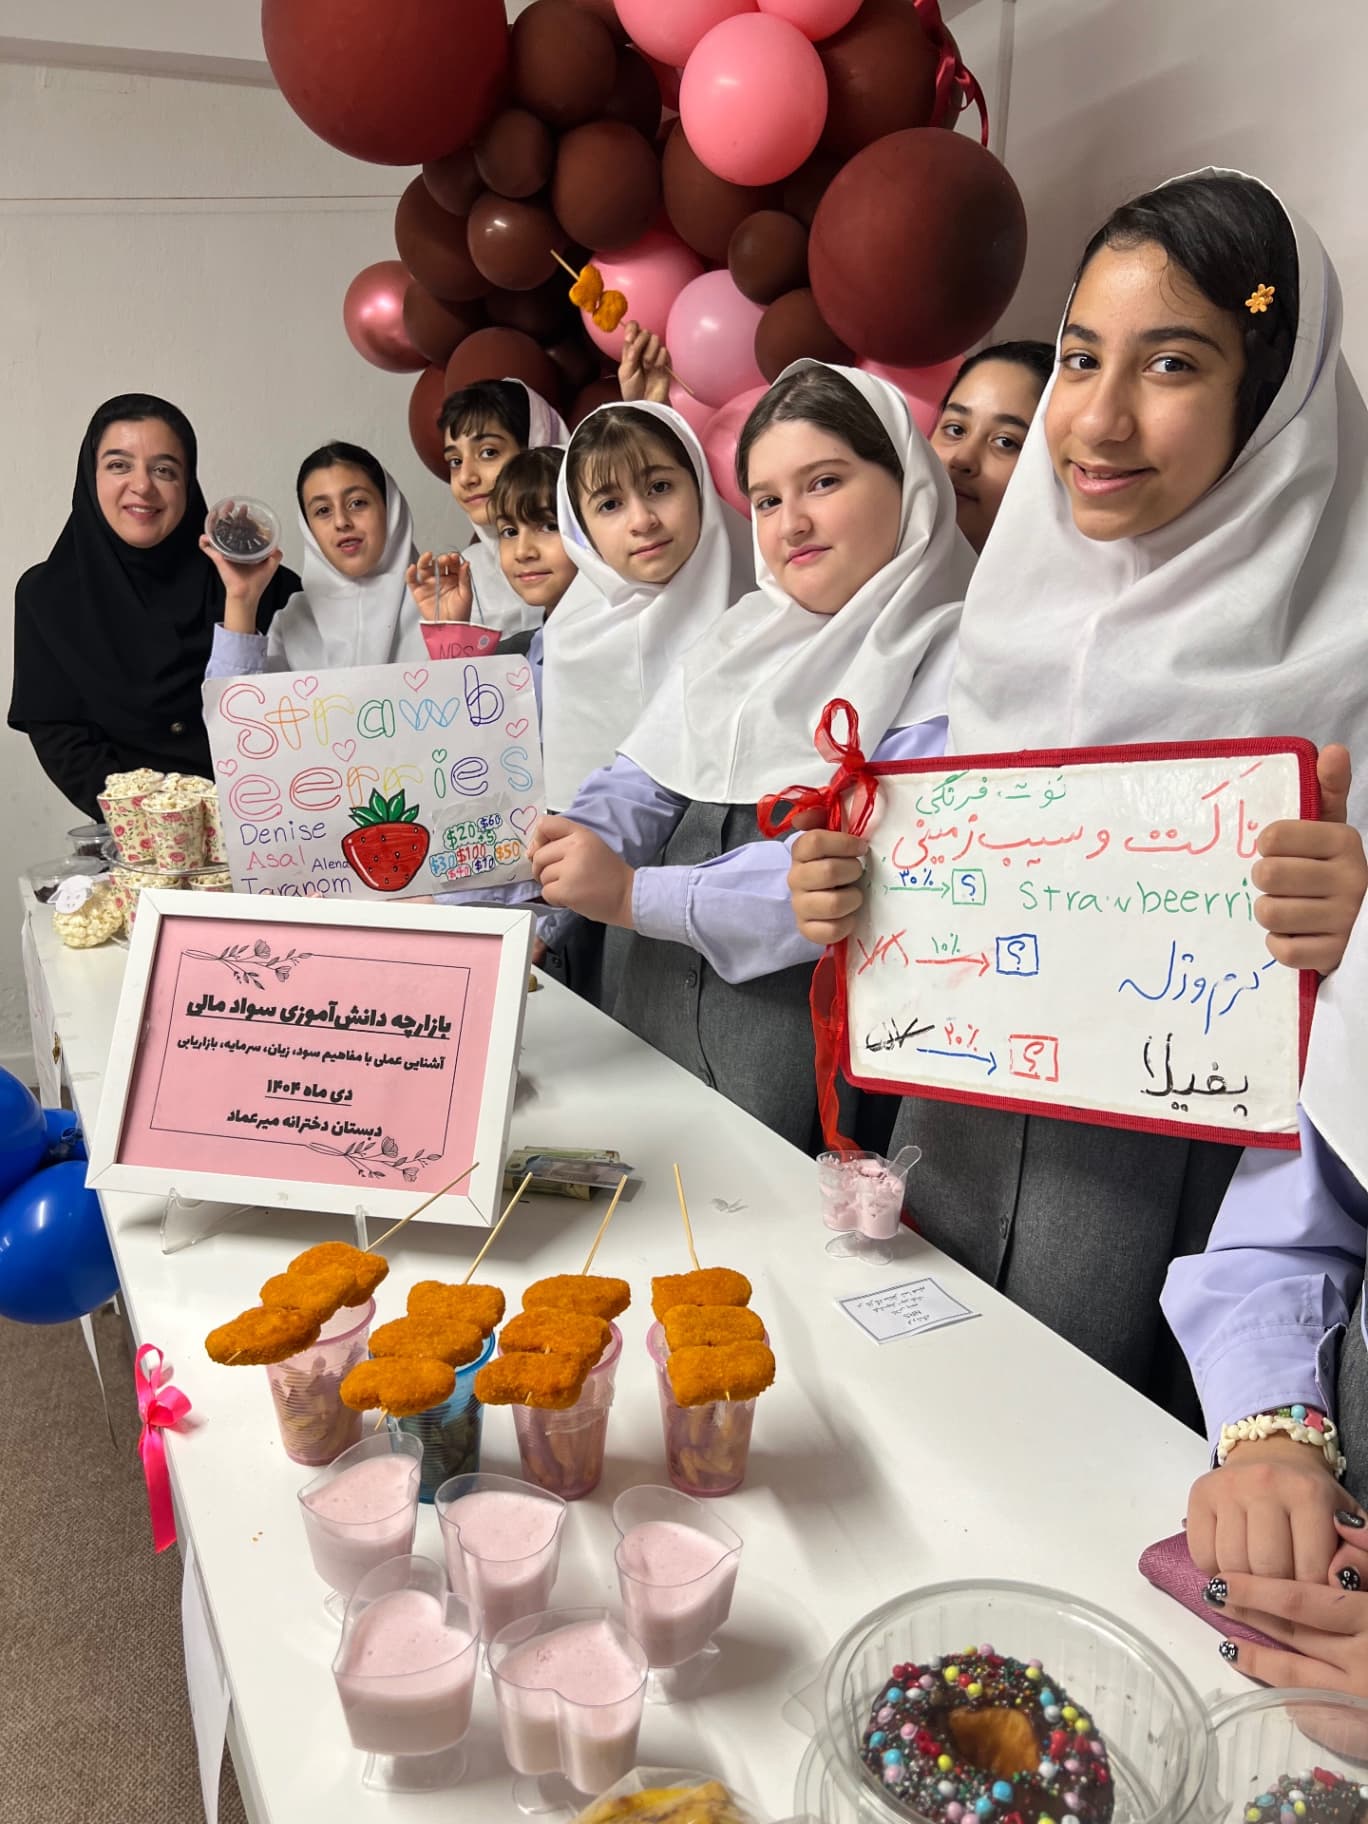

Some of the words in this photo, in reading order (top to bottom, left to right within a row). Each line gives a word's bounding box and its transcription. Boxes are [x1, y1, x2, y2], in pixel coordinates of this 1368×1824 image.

[219, 664, 505, 759] Strawb
[240, 820, 327, 846] Denise
[446, 824, 476, 850] $20
[456, 844, 486, 863] $100
[495, 841, 520, 860] $50
[1086, 829, 1110, 860] و
[247, 844, 305, 871] Asal
[312, 858, 349, 872] Alena
[186, 994, 226, 1016] مالی
[229, 998, 277, 1021] سواد
[391, 1014, 452, 1039] بازارچه
[177, 1035, 218, 1050] بازاریابی
[322, 1050, 362, 1063] مفاهیم
[364, 1052, 372, 1066] با
[374, 1054, 402, 1067] عملی
[404, 1056, 446, 1071] آشنایی
[266, 1079, 300, 1095] ۱۴۰۴
[303, 1084, 327, 1098] ماه
[330, 1089, 353, 1103] دی
[227, 1110, 279, 1129] میرعماد
[282, 1115, 328, 1133] دخترانه
[331, 1121, 382, 1140] دبستان
